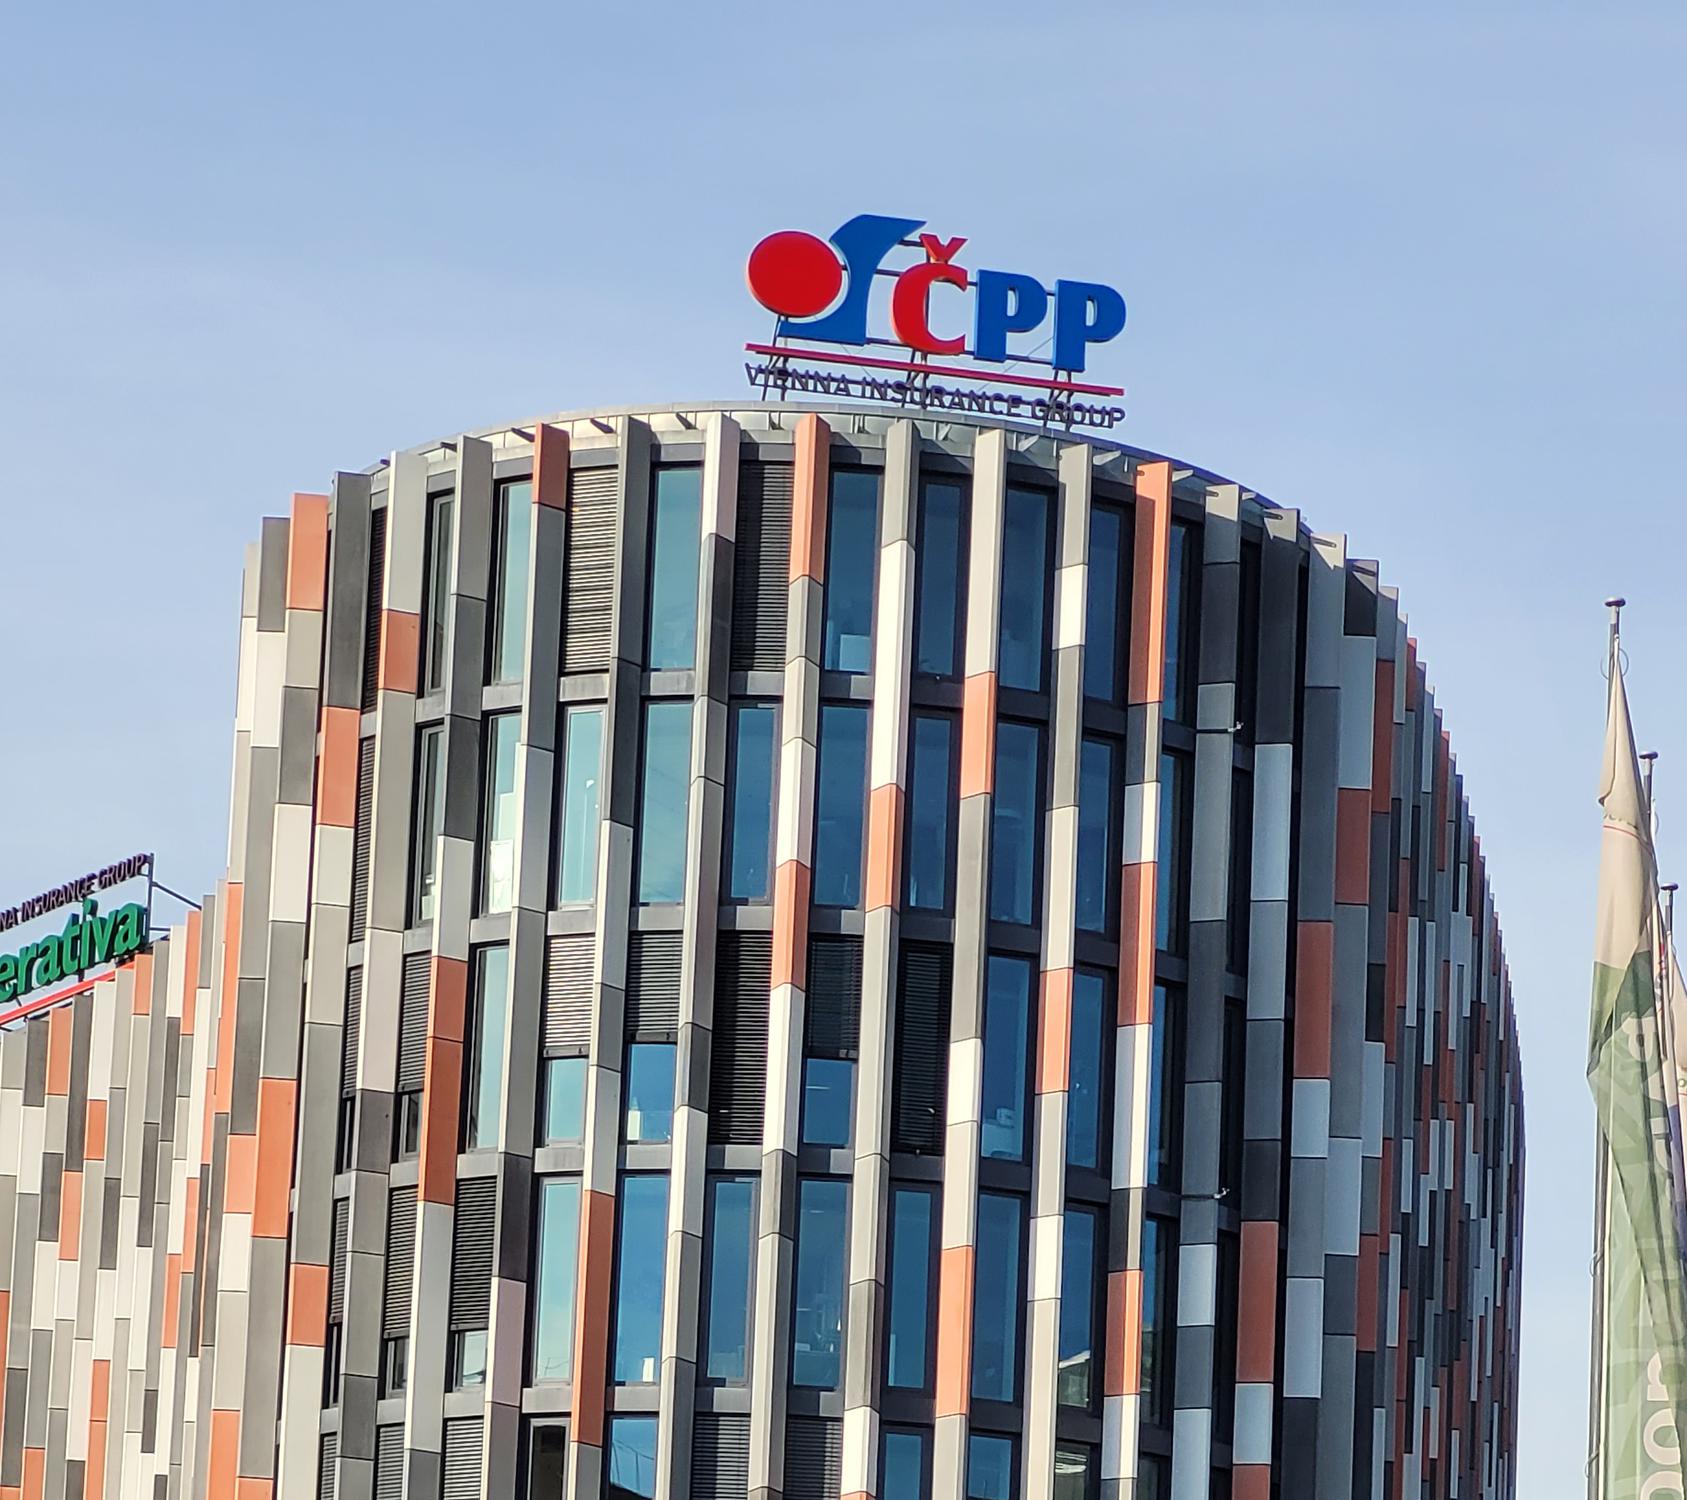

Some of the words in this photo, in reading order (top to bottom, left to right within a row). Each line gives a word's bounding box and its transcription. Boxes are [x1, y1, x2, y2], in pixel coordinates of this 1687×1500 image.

[892, 233, 1127, 372] ČPP
[745, 363, 851, 396] VIENNA
[860, 376, 1022, 417] INSURANCE
[1032, 398, 1126, 429] GROUP
[21, 873, 97, 922] INSURANCE
[97, 853, 150, 890] GROUP
